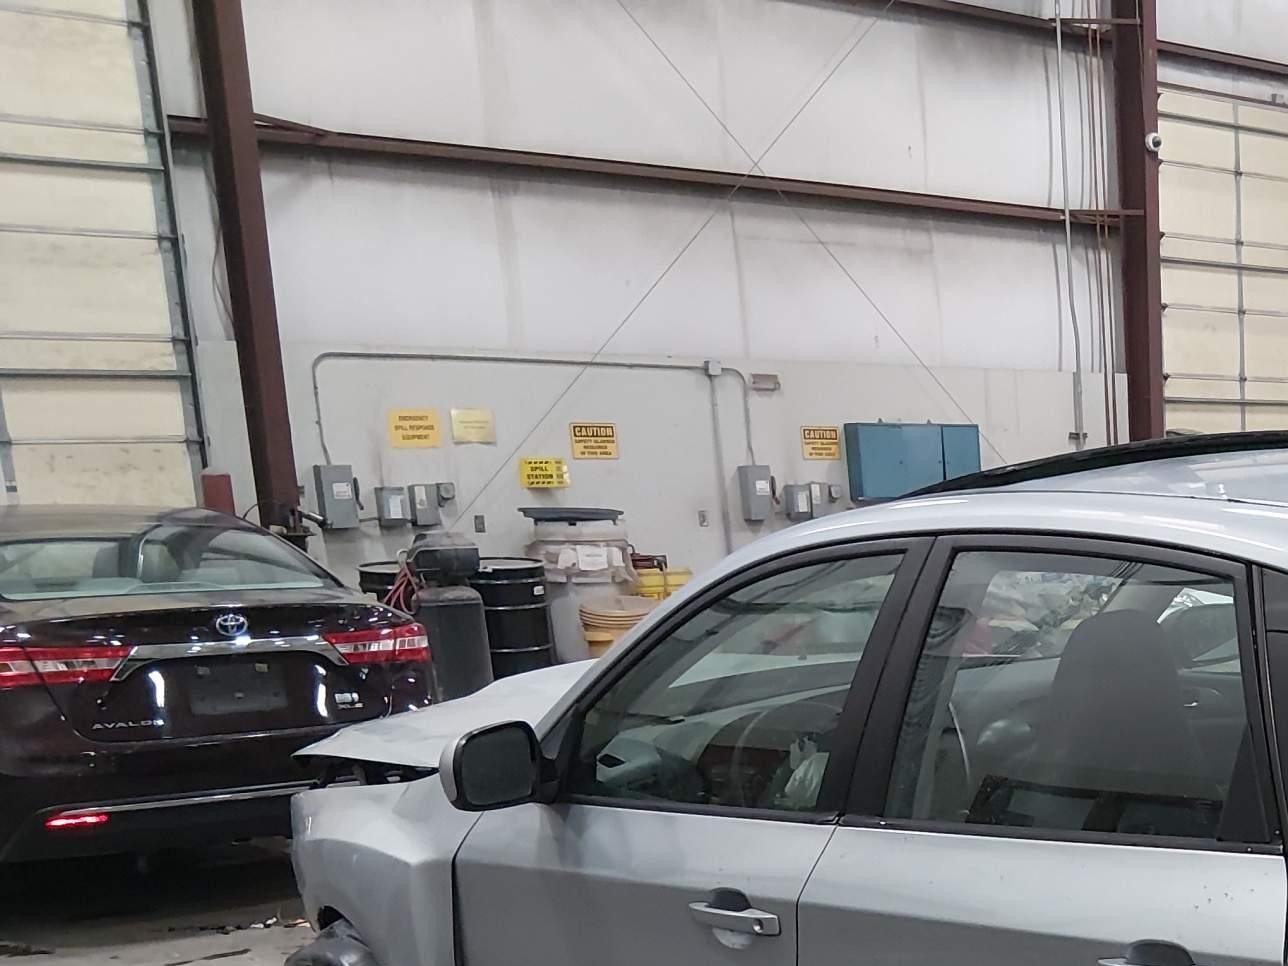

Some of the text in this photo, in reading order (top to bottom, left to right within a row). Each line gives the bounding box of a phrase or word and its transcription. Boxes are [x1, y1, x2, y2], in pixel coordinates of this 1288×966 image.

[574, 427, 613, 437] CAUTION
[804, 430, 836, 439] CAUTION
[91, 719, 165, 730] AVALON
